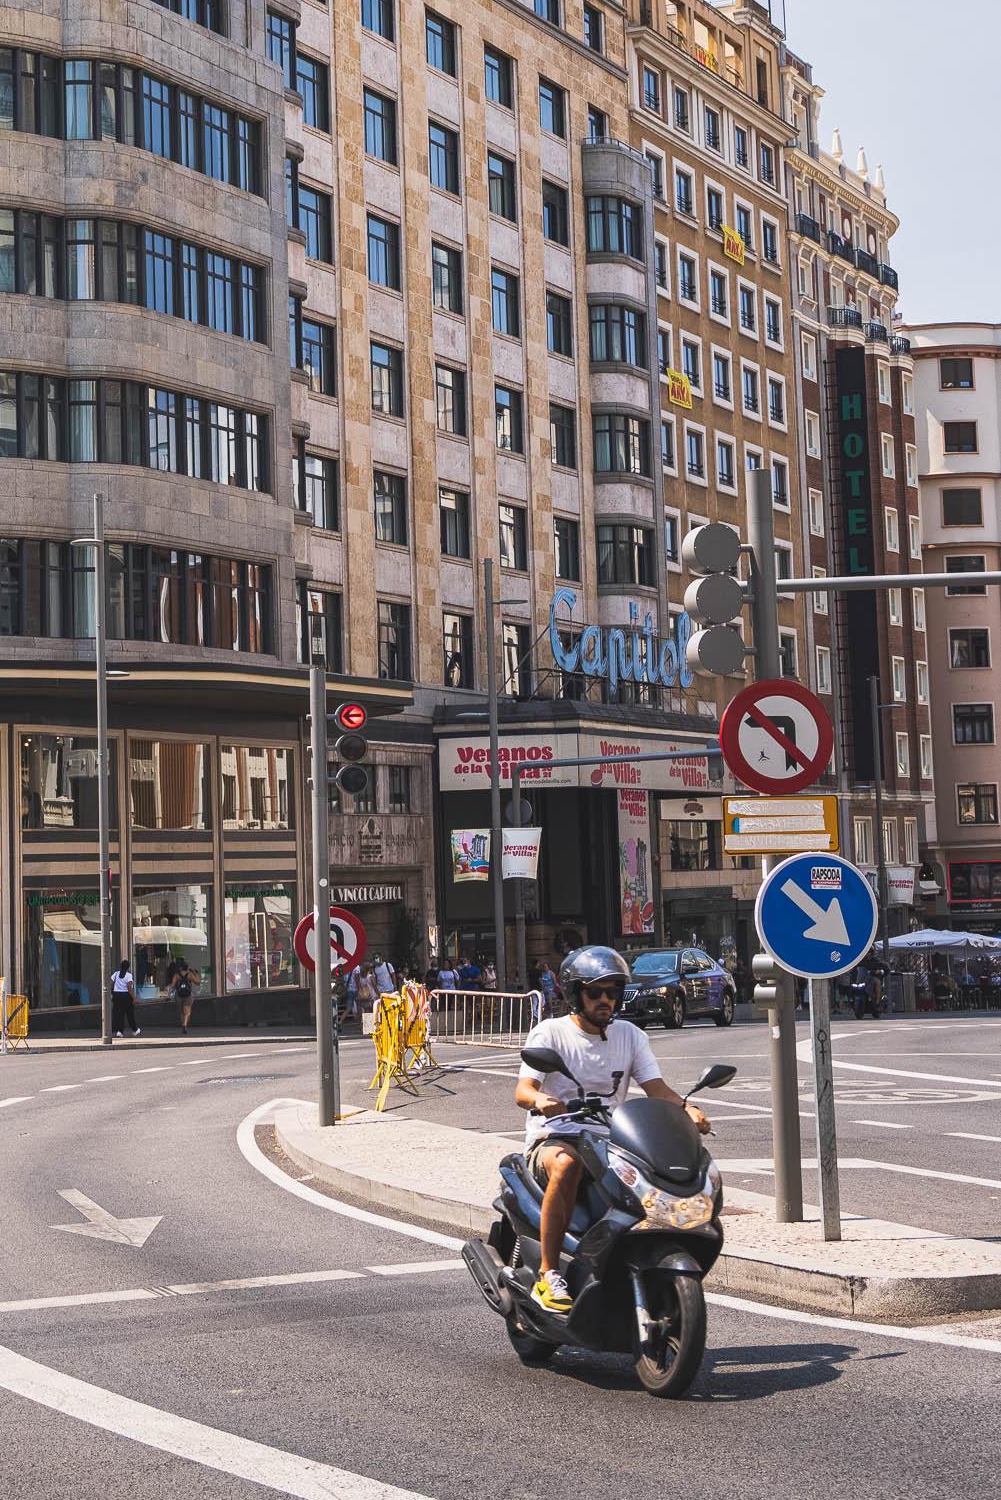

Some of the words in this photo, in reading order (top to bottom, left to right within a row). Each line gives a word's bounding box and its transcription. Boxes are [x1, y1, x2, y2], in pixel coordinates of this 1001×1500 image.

[841, 394, 869, 575] HOTEL
[549, 587, 695, 697] Capitol
[454, 764, 470, 774] de
[471, 764, 483, 773] la
[504, 844, 538, 853] Veranos
[812, 868, 841, 881] RAPSODA
[338, 887, 368, 902] VINCCI
[369, 885, 404, 900] CAPITOL
